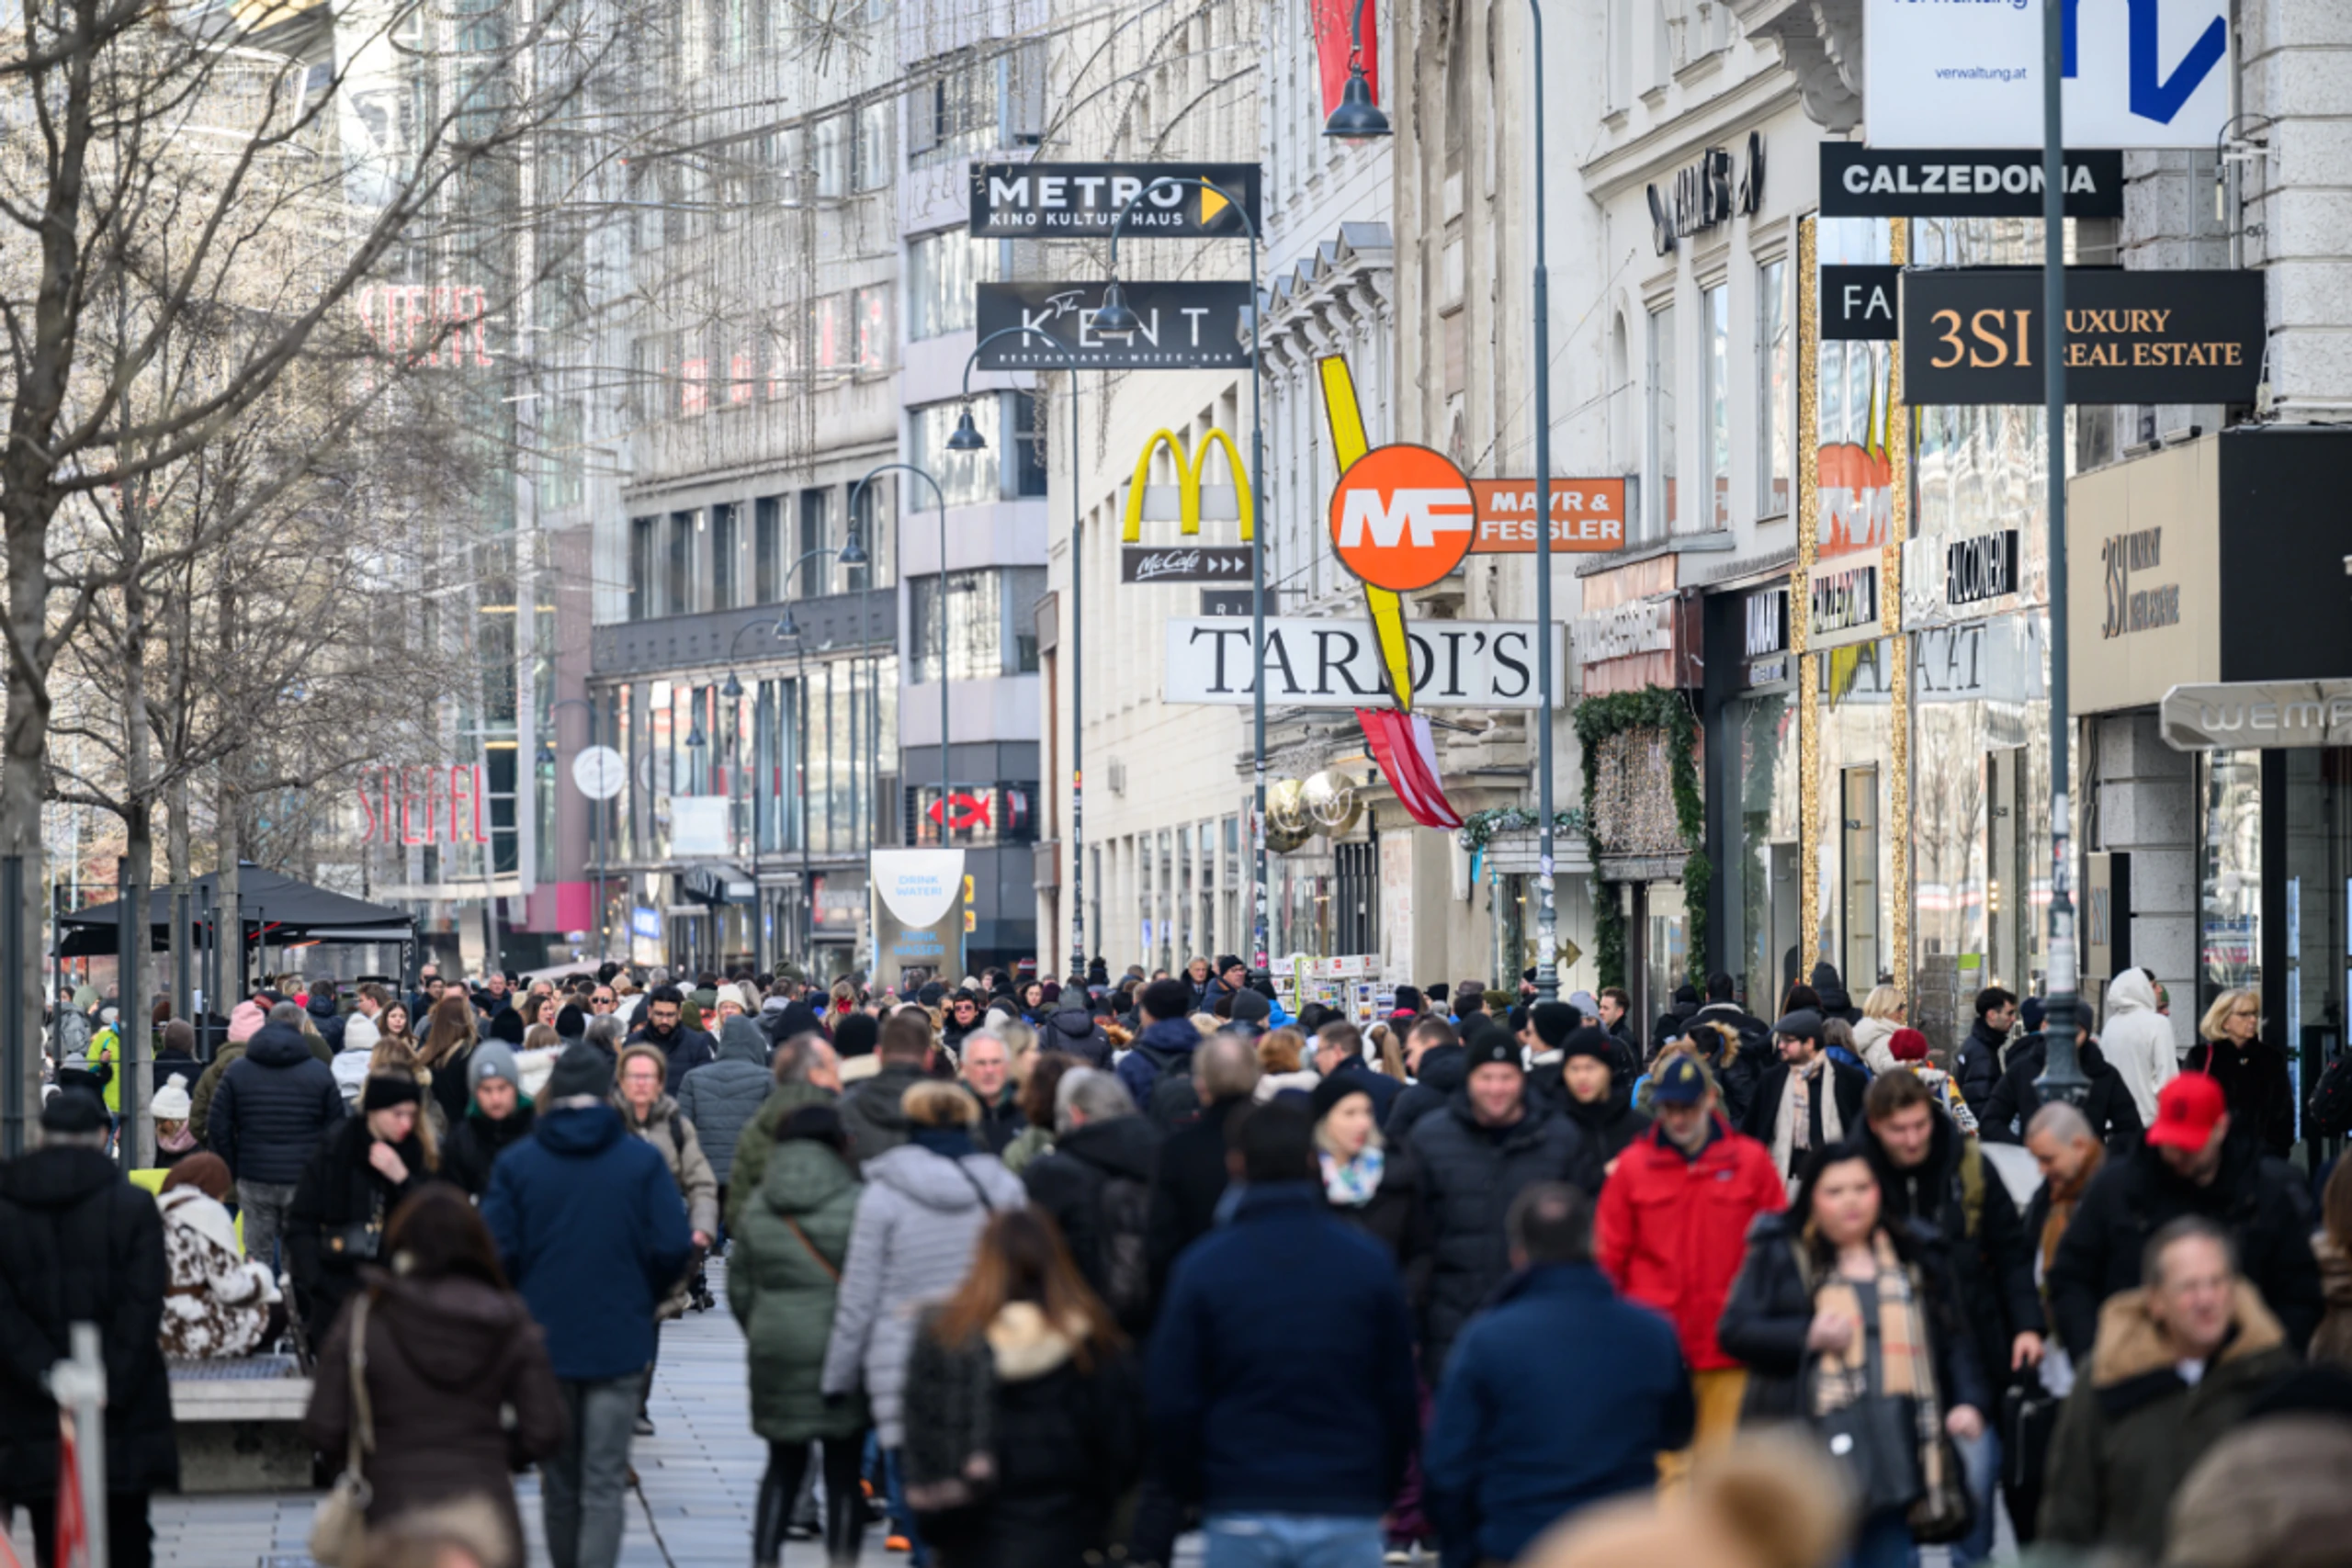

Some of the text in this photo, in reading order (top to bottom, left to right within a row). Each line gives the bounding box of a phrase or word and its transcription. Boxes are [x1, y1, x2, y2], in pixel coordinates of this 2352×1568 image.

[1935, 67, 2027, 82] verwaltung.at
[989, 176, 1183, 208] METRO
[989, 212, 1183, 225] KINO KULTUR HAUS
[1023, 308, 1209, 347] KENT
[1930, 310, 2171, 367] 3SI UXURY
[1202, 354, 1233, 362] BAR
[2133, 343, 2243, 366] ESTATE
[1590, 493, 1610, 512] &
[1338, 489, 1474, 547] MF
[1481, 519, 1621, 540] FESSLER
[899, 875, 938, 885] DRINK
[901, 931, 937, 942] TRINK
